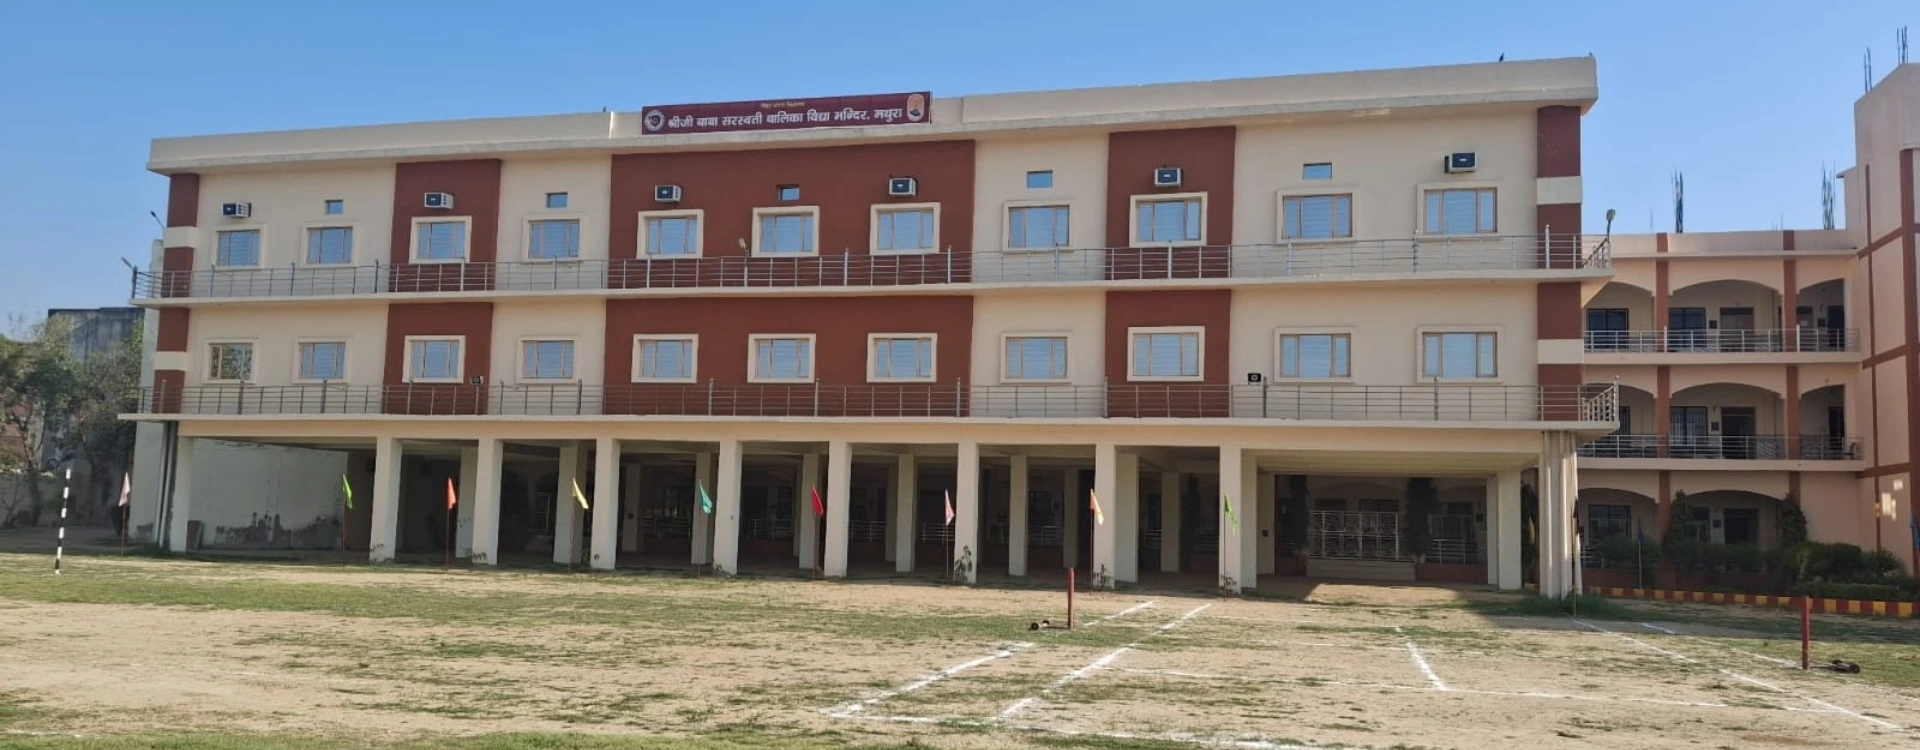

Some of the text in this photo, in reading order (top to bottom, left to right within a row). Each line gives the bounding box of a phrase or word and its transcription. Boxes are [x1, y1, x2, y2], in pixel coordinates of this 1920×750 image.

[668, 115, 693, 128] श्रीजी
[722, 111, 763, 125] सरस्वती
[766, 111, 804, 124] बालिका
[807, 109, 830, 122] विद्या
[874, 108, 902, 123] मथुरा
